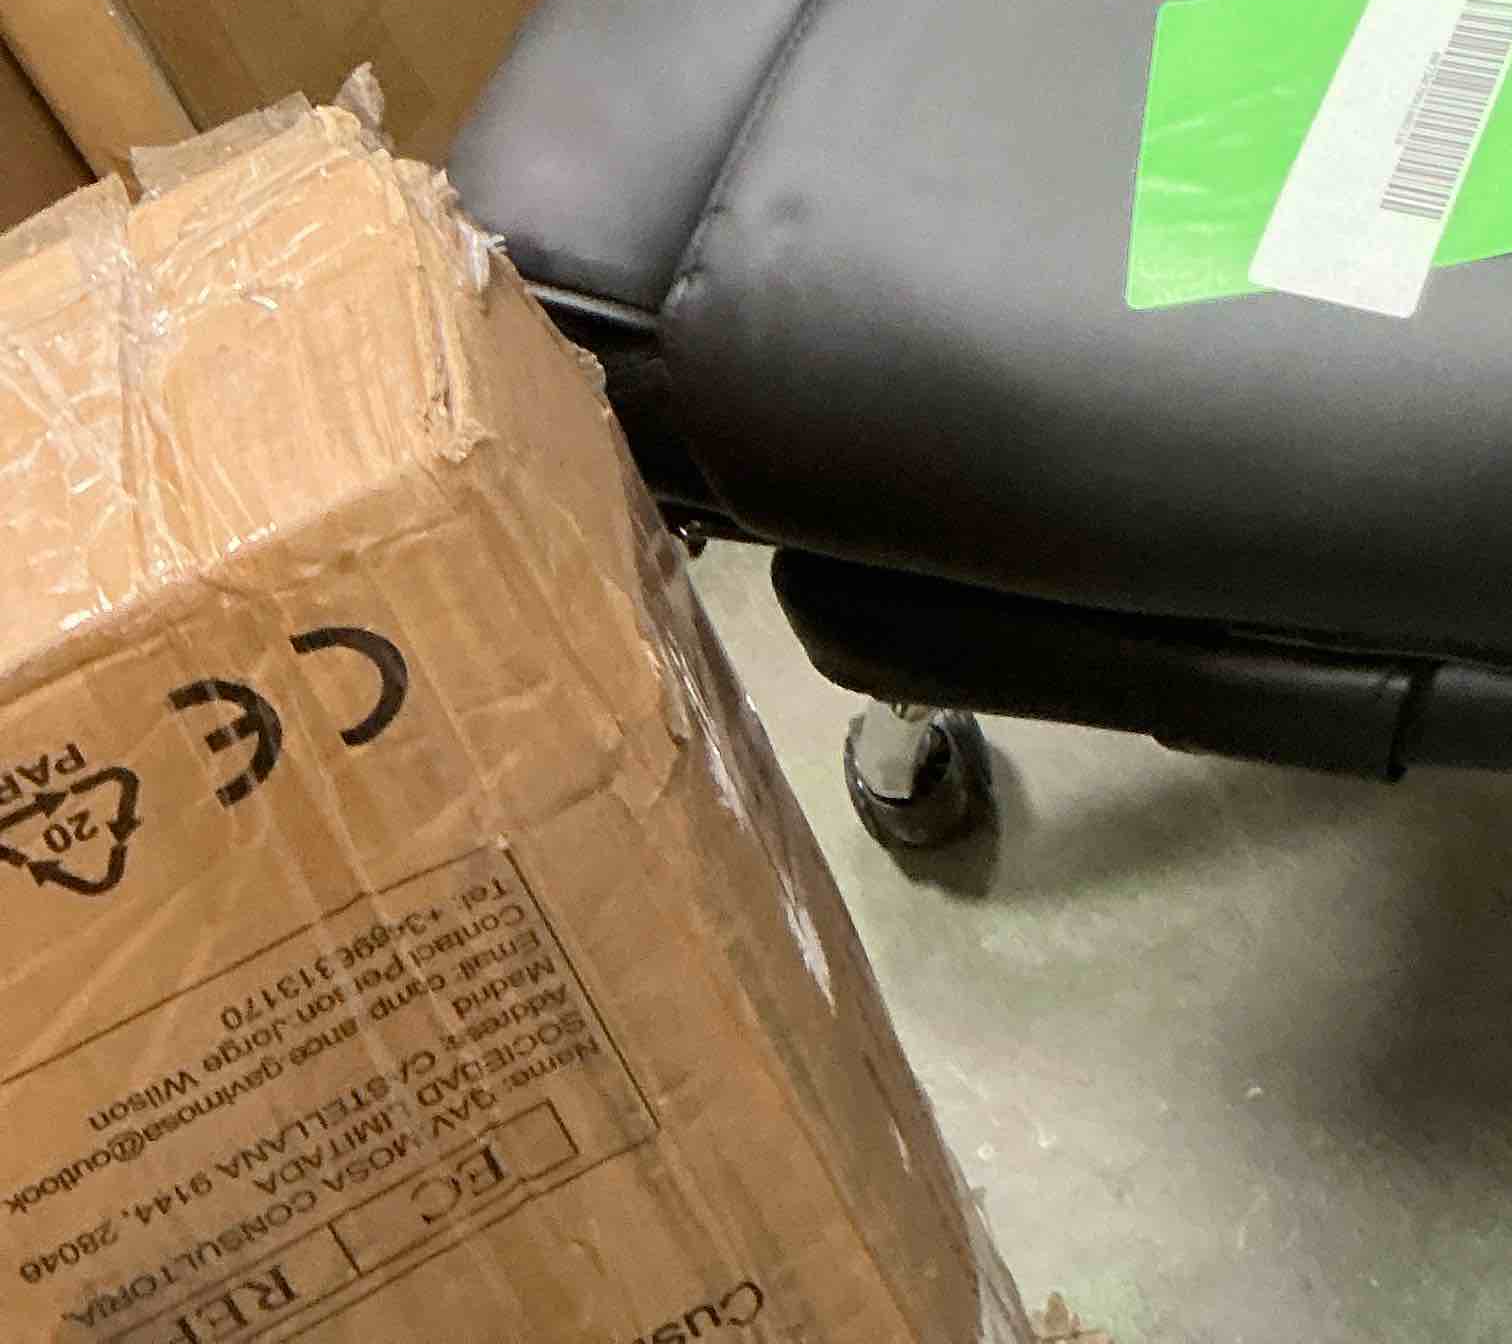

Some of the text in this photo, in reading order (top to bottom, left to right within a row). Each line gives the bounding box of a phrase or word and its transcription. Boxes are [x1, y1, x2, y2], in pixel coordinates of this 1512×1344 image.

[42, 810, 99, 854] 20
[451, 951, 558, 1023] Madrid
[198, 1012, 294, 1081] Jorge
[411, 1003, 589, 1113] SOCIEDAD
[88, 1065, 200, 1140] Wilson
[405, 1144, 510, 1227] EC
[634, 1282, 764, 1344] Cus
